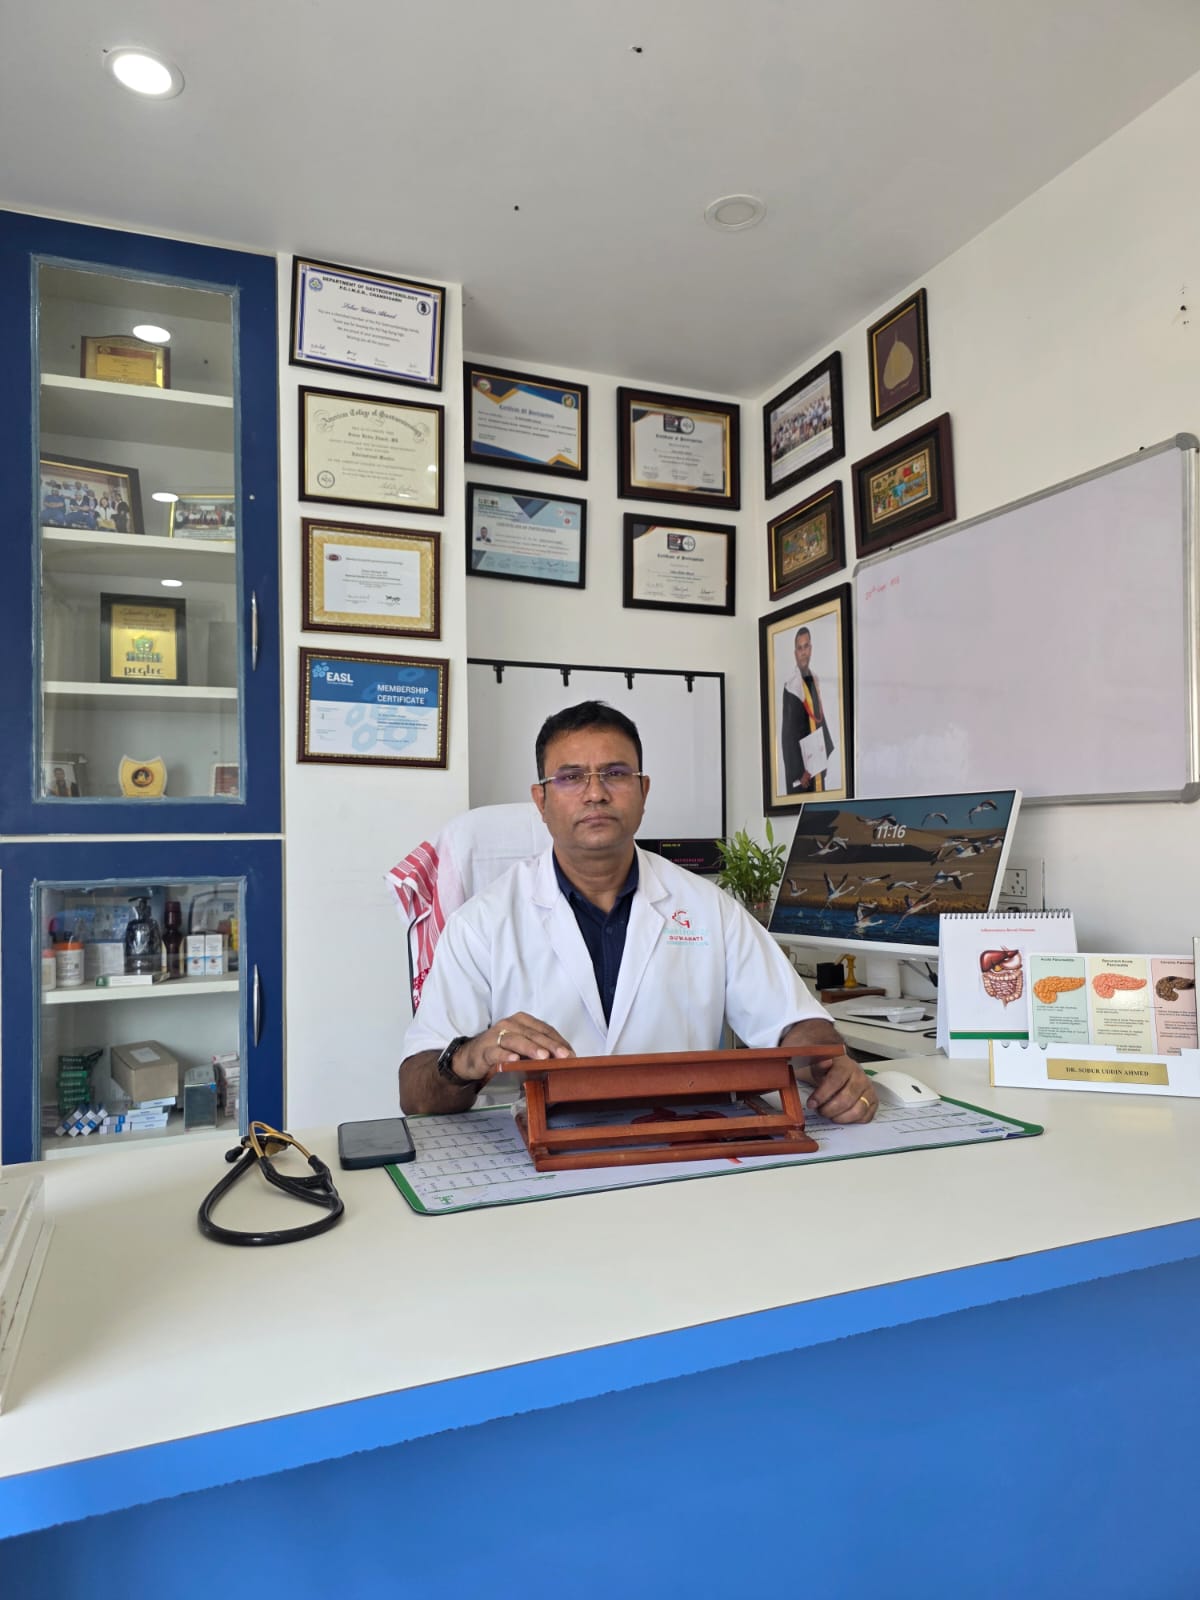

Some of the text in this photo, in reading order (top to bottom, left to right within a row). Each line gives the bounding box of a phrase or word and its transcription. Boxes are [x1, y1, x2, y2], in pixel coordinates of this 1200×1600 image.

[322, 276, 356, 288] DEPARTMENT
[326, 671, 354, 683] EASL
[377, 684, 429, 695] MEMBERSHIP
[377, 694, 425, 705] CERTIFICATE
[877, 825, 907, 839] 11:16
[1124, 1069, 1149, 1077] AHMED
